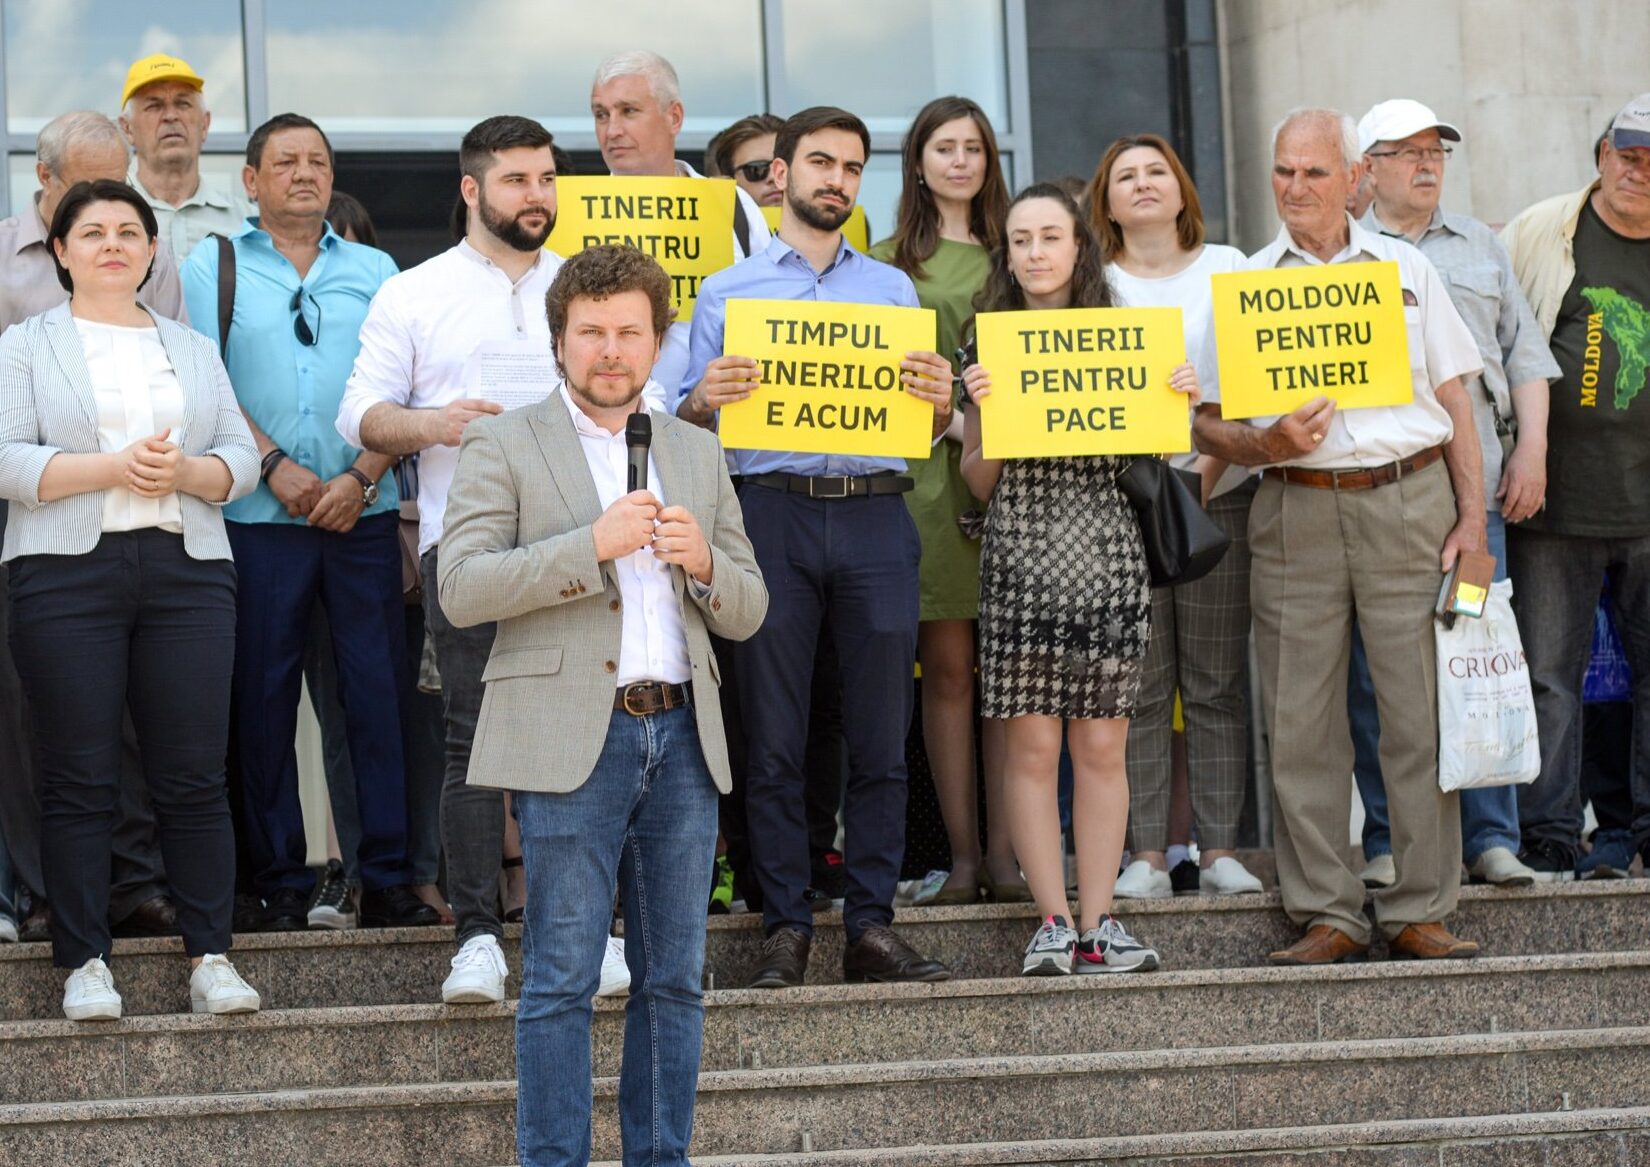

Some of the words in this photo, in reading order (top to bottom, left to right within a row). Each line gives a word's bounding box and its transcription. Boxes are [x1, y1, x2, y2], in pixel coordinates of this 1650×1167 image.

[581, 196, 699, 221] TINERII
[1239, 281, 1381, 314] MOLDOVA
[765, 319, 889, 350] TIMPUL
[1018, 327, 1146, 354] TINERII
[1255, 321, 1373, 352] PENTRU
[1580, 311, 1604, 408] MOLDOVA
[746, 359, 918, 392] INERILO
[1020, 366, 1148, 394] PENTRU
[1265, 360, 1369, 391] TINERI
[766, 401, 785, 427] E
[794, 403, 888, 432] ACUM
[1046, 406, 1127, 433] PACE
